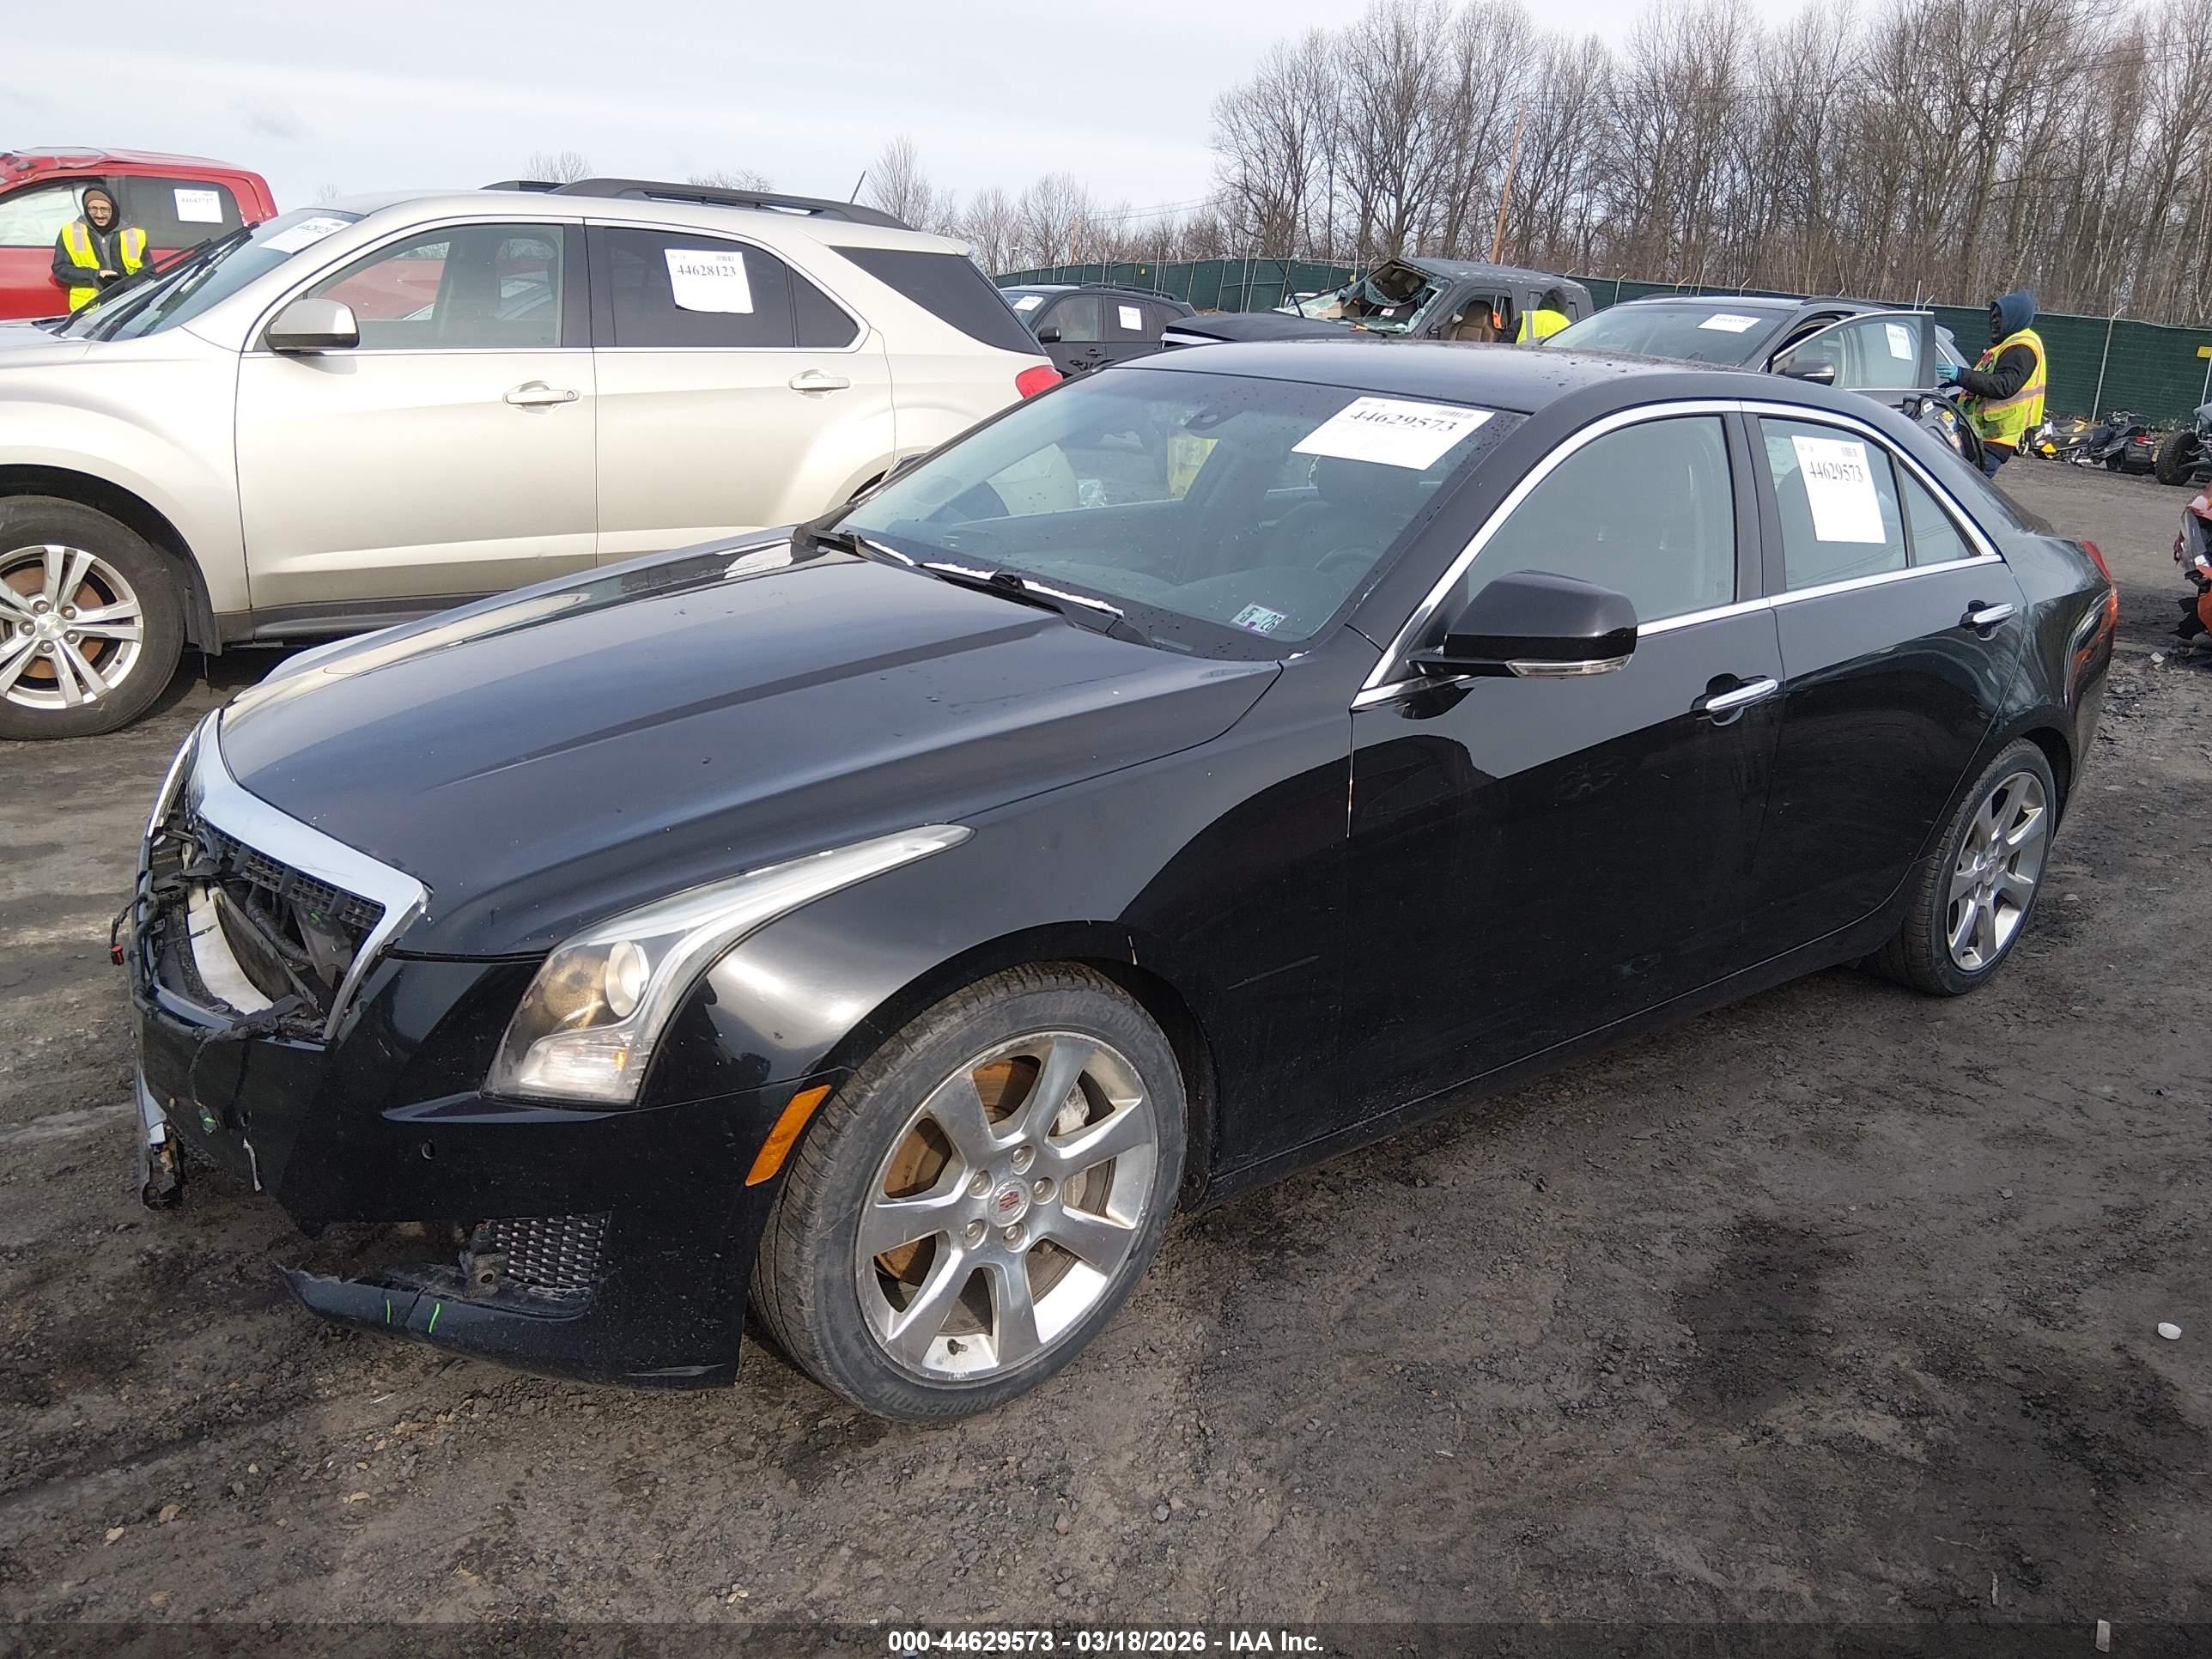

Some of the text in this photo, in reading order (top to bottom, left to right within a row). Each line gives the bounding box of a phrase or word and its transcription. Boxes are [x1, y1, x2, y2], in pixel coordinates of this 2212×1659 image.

[677, 264, 736, 276] 44628123
[1351, 410, 1458, 431] 44629573
[1809, 461, 1863, 482] 44629573
